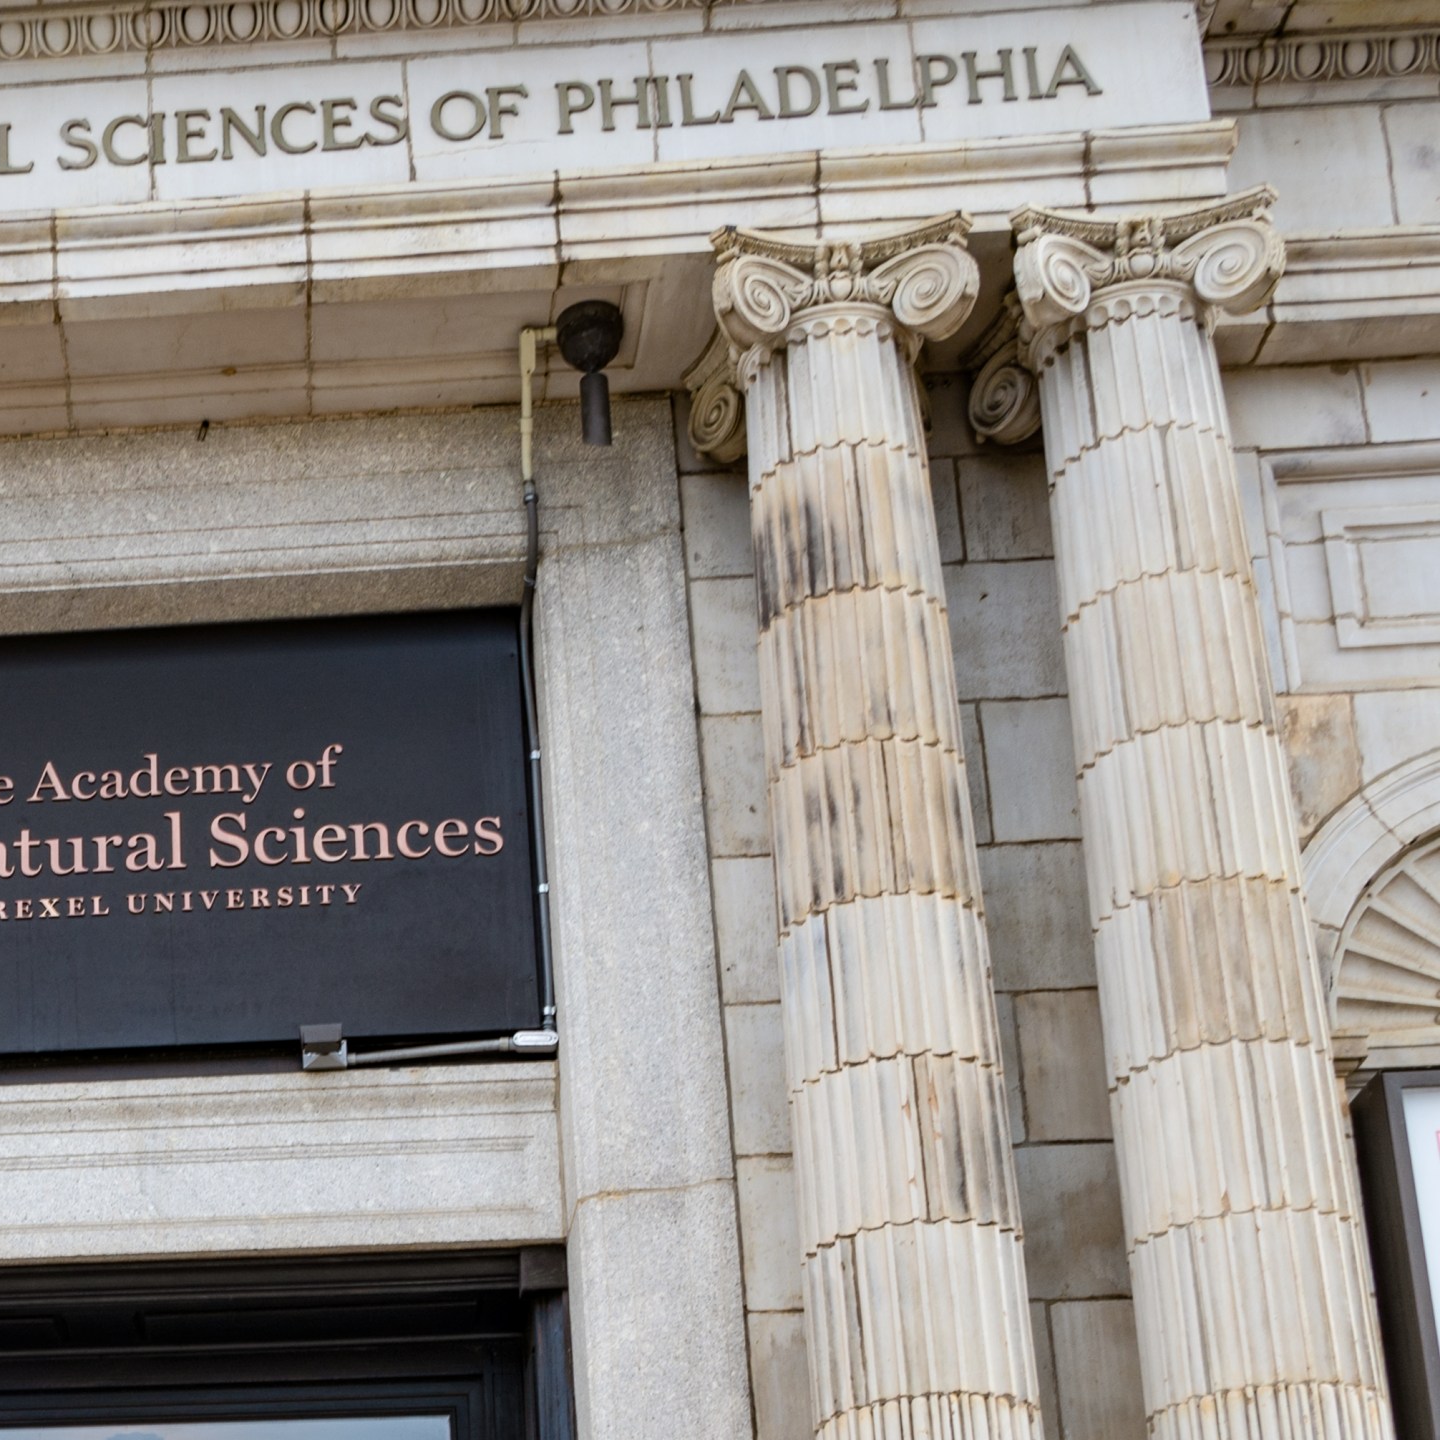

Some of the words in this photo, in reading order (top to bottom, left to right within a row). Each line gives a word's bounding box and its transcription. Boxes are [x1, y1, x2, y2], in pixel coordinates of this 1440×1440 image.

[57, 94, 410, 171] SCIENCES
[430, 84, 529, 141] OF
[555, 44, 1103, 135] PHILADELPHIA
[26, 752, 273, 804] Academy
[286, 744, 343, 790] of
[210, 807, 505, 869] Sciences
[126, 883, 363, 914] UNIVERSITY
